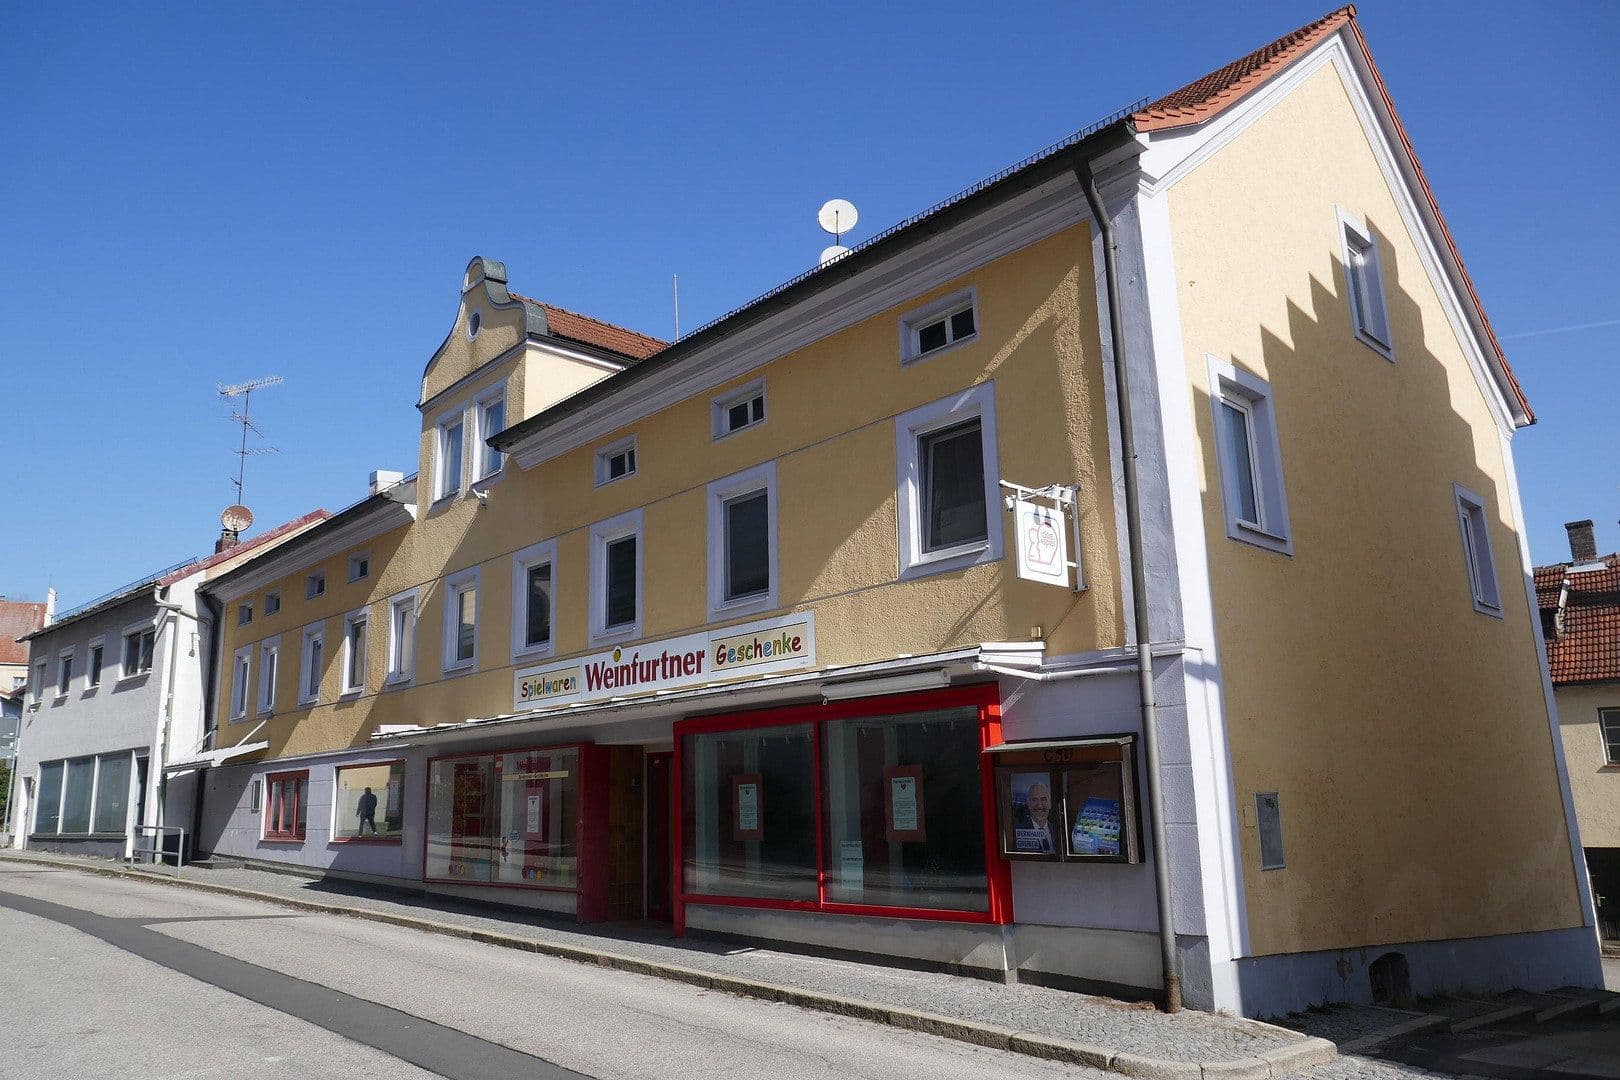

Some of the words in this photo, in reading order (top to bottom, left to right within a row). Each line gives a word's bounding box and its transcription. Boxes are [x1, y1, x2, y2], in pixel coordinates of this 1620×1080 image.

[521, 676, 577, 701] Spielwaren
[585, 649, 705, 692] Weinfurtner
[716, 632, 802, 665] Geschenke
